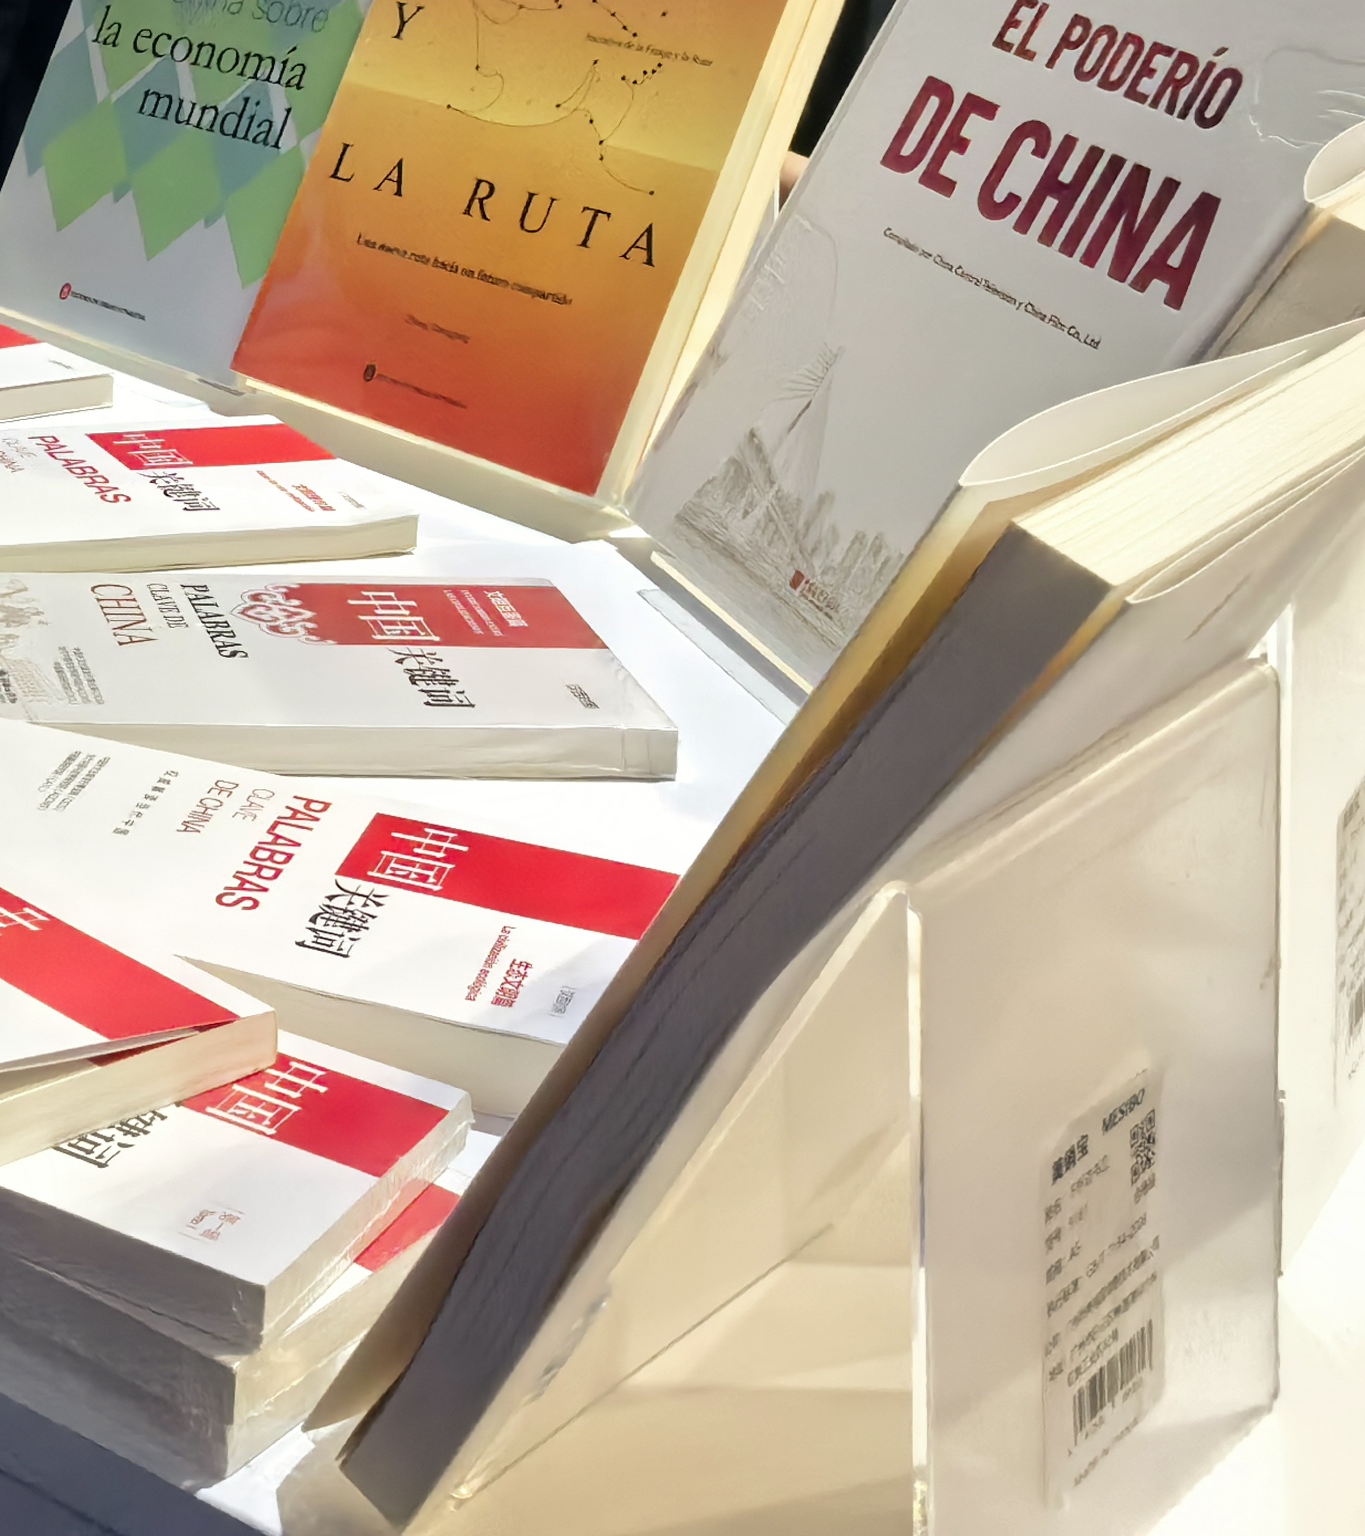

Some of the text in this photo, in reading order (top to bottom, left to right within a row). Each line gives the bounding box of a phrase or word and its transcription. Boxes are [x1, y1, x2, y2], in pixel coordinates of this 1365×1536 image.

[91, 4, 308, 91] la economía
[389, 1, 425, 43] Y
[1044, 11, 1245, 131] PODERÍO
[137, 88, 293, 151] mundial
[329, 142, 658, 269] LA RUTA
[879, 74, 1223, 312] DE CHINA
[27, 434, 132, 505] PALABRAS
[113, 432, 194, 467] 中国
[136, 471, 221, 513] 关键词
[90, 583, 159, 646] CHINA
[146, 582, 190, 630] CLAVE DE
[180, 582, 249, 660] PALABRAS
[347, 591, 441, 641] 中国
[386, 647, 476, 708] 关键词
[176, 779, 239, 834] DE CHINA
[231, 788, 276, 822] CLAVE
[214, 795, 333, 912] PALABRAS
[367, 827, 470, 892] 中国
[294, 878, 391, 959] 关键词
[205, 1060, 328, 1136] 中国
